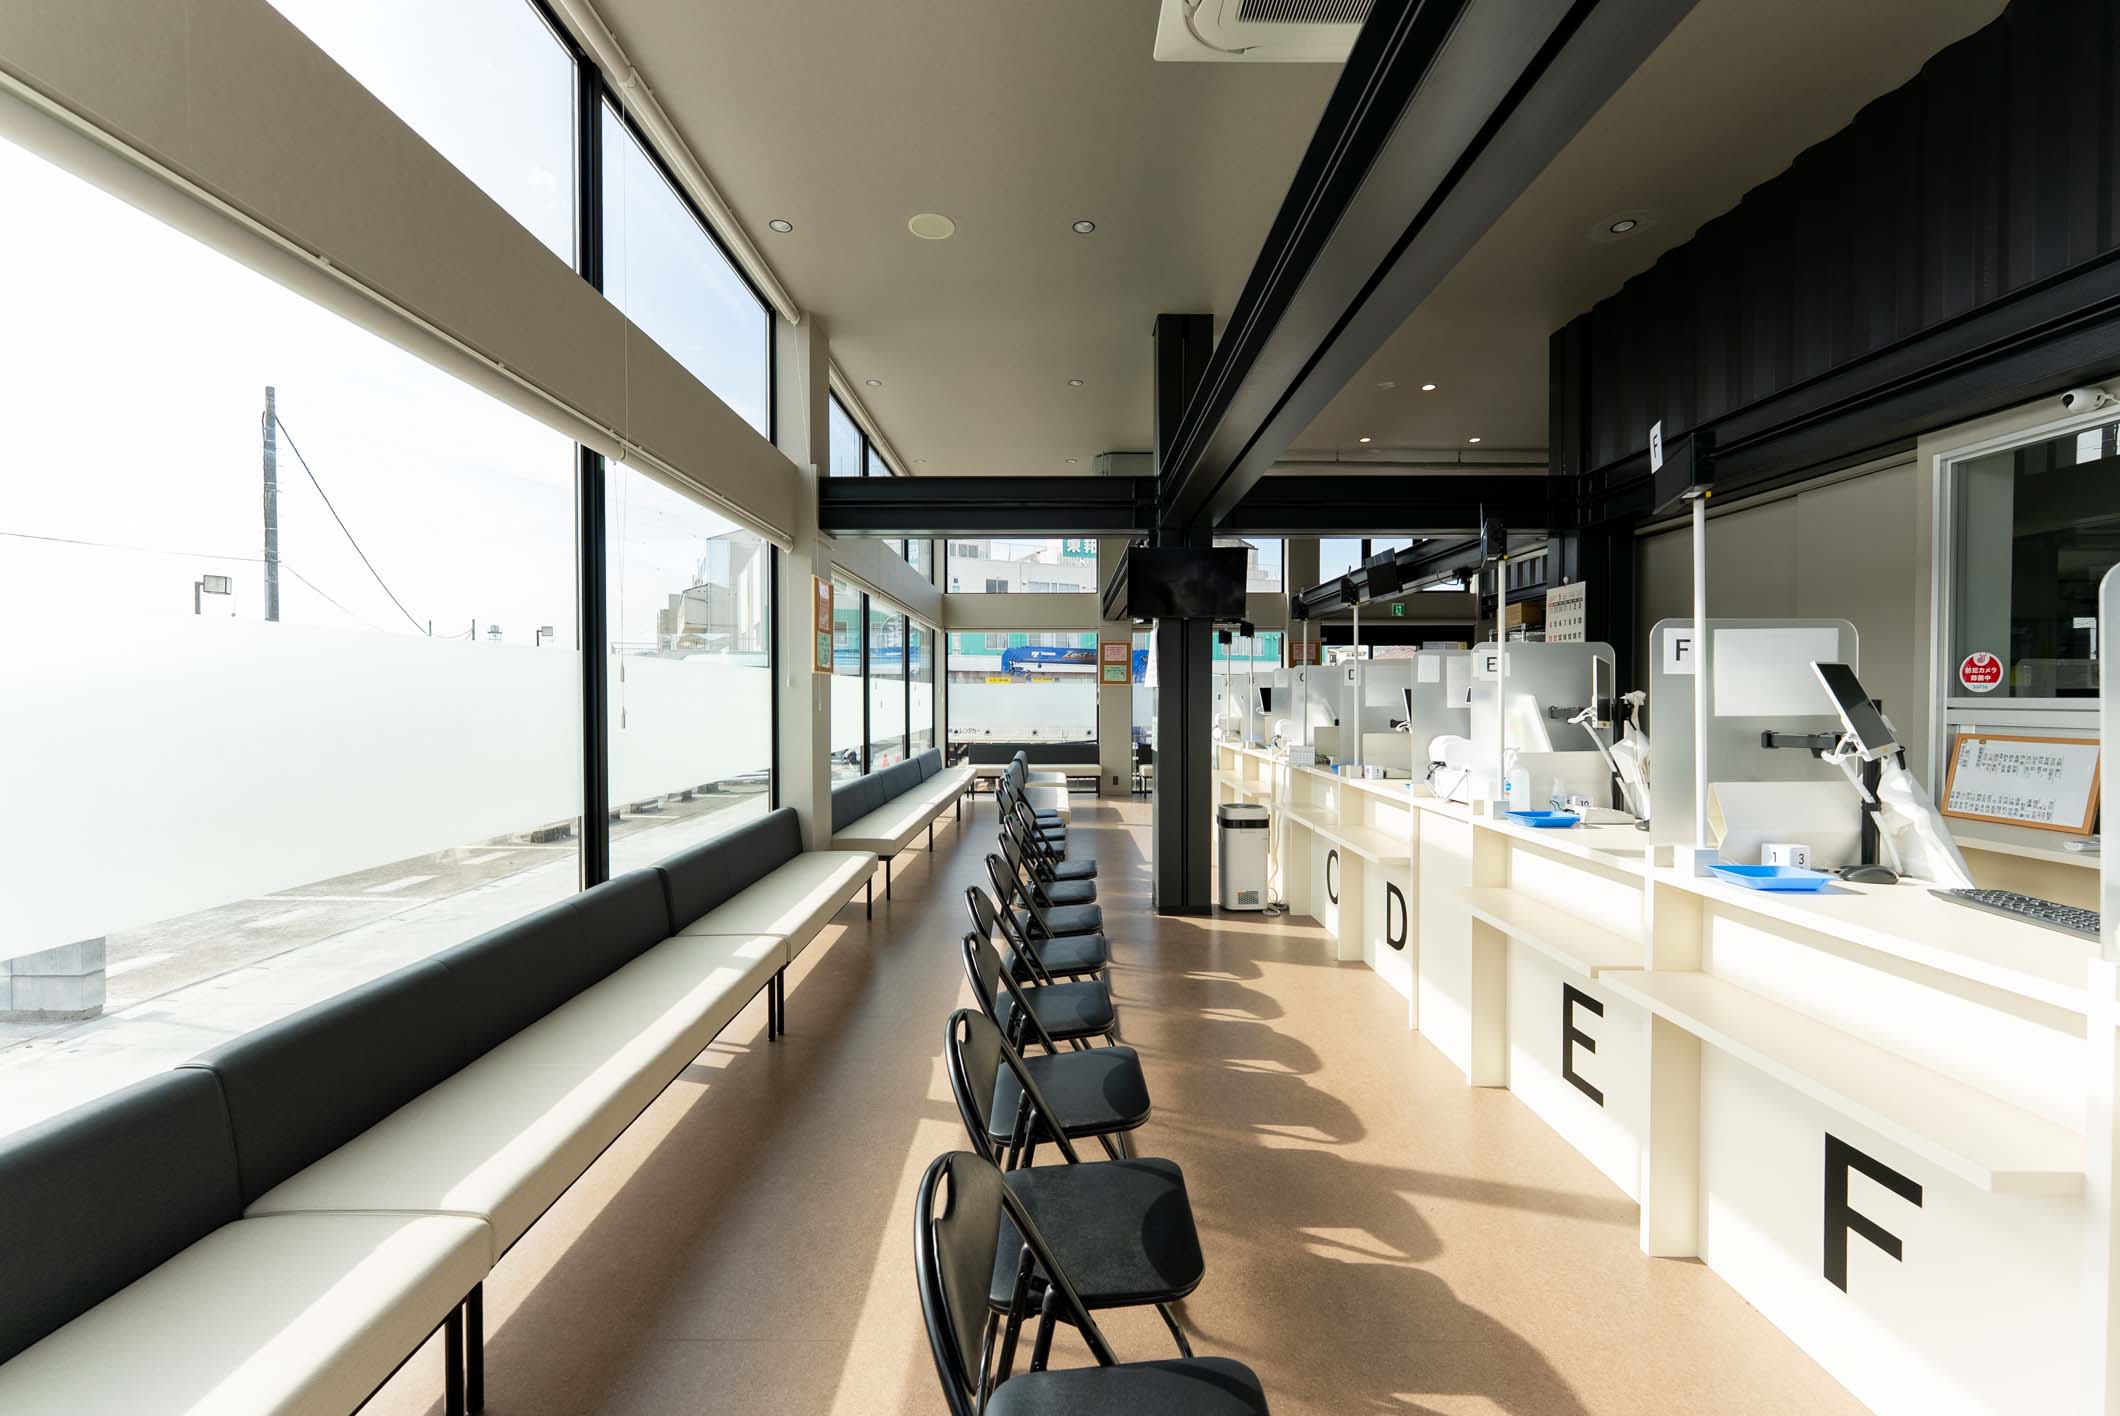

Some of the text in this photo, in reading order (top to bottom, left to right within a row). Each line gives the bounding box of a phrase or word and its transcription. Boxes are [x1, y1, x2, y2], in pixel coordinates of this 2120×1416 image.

[1652, 434, 1658, 459] F
[1675, 639, 1691, 662] F
[1486, 656, 1498, 672] E
[1772, 851, 1777, 864] 1
[1798, 853, 1805, 865] 3
[1386, 880, 1408, 952] D
[1562, 981, 1604, 1109] E
[1823, 1131, 1924, 1295] F
